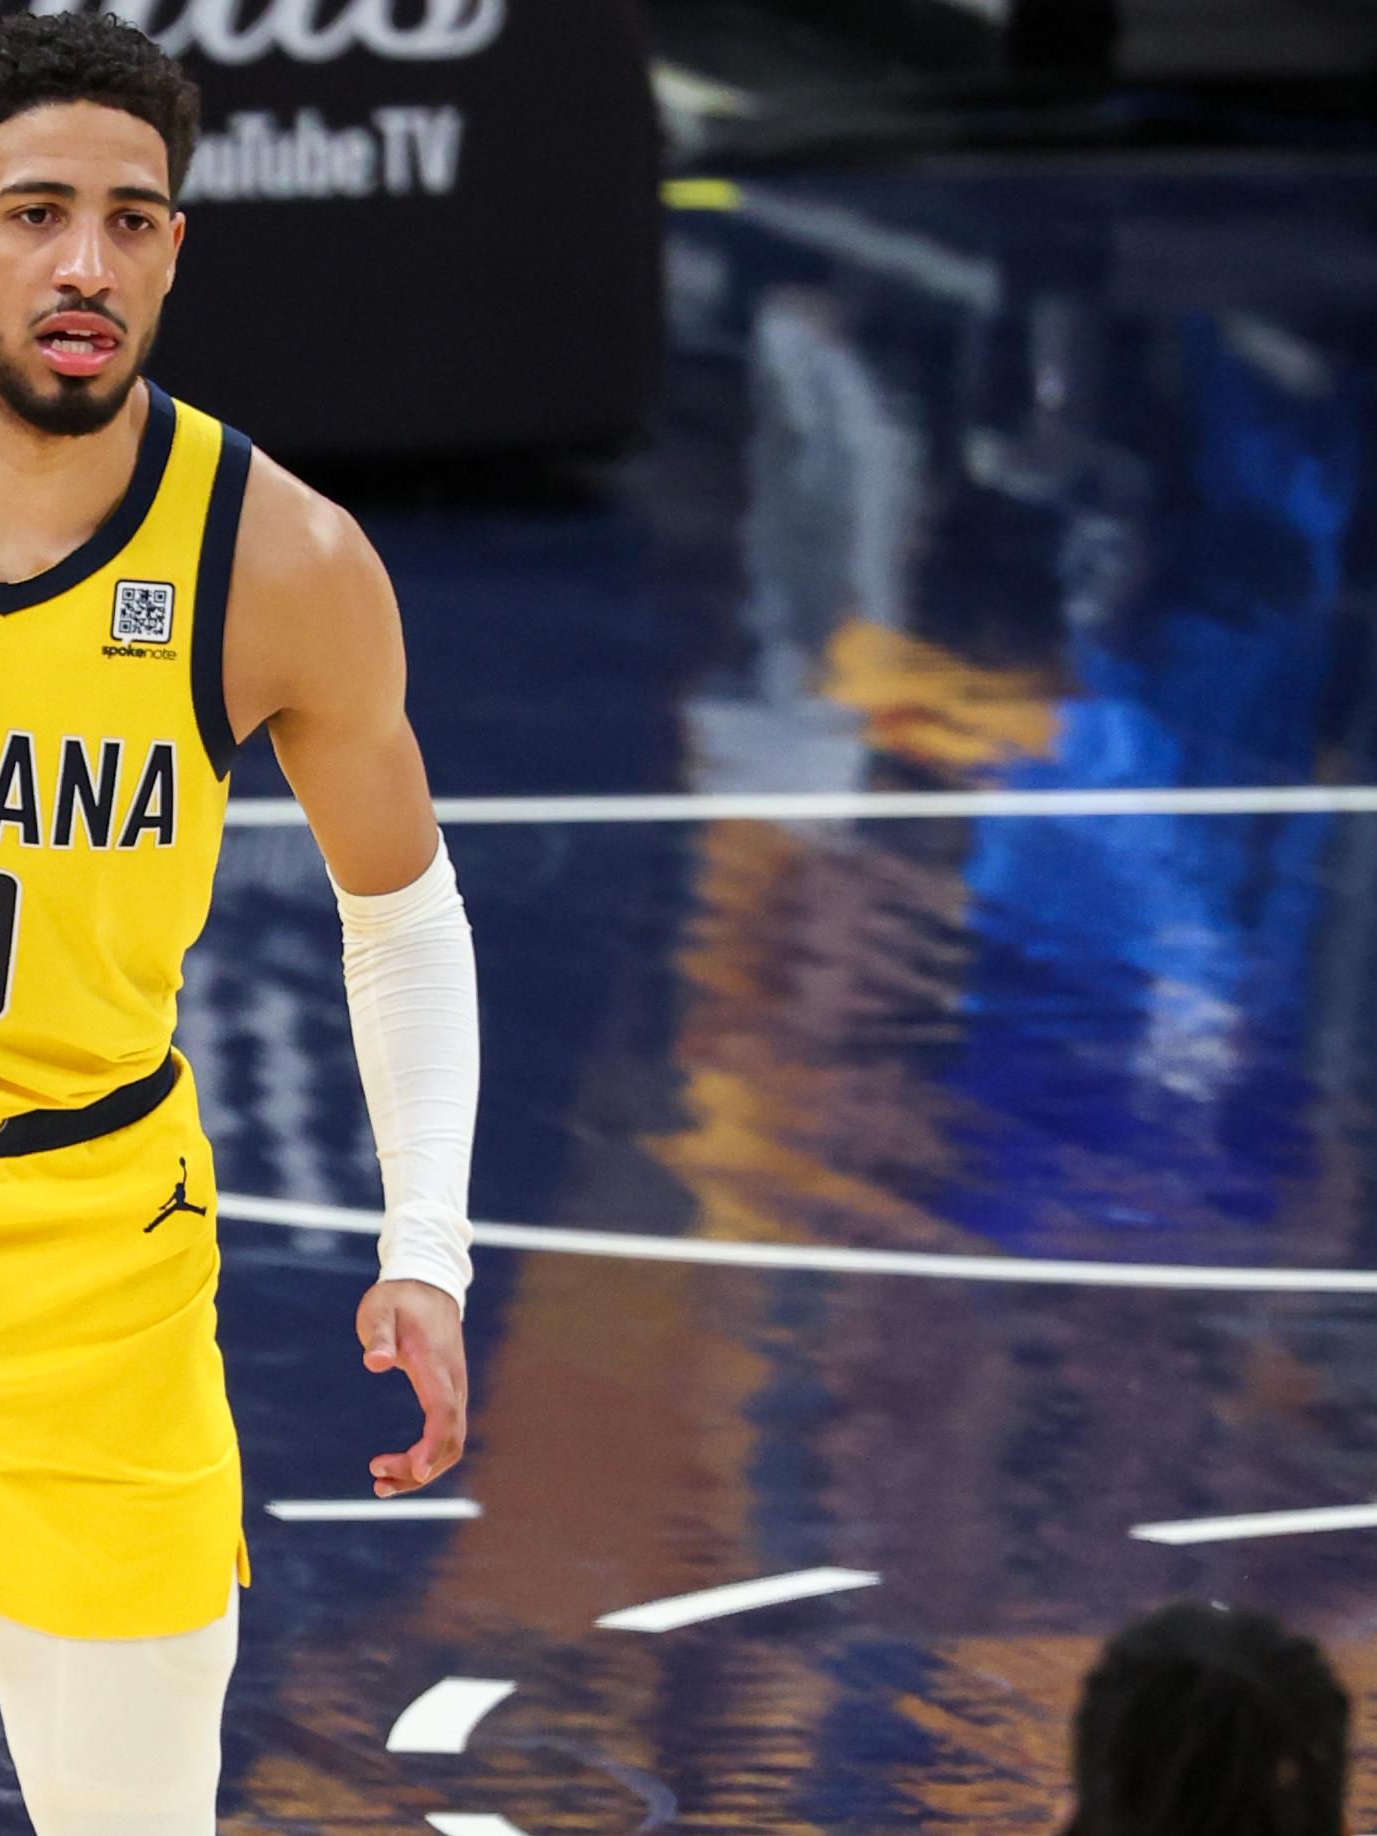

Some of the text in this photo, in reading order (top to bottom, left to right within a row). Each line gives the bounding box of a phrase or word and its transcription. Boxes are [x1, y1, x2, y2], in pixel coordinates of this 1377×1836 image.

[180, 108, 373, 201] ouTube
[372, 105, 462, 195] TV
[101, 644, 177, 661] spokenote
